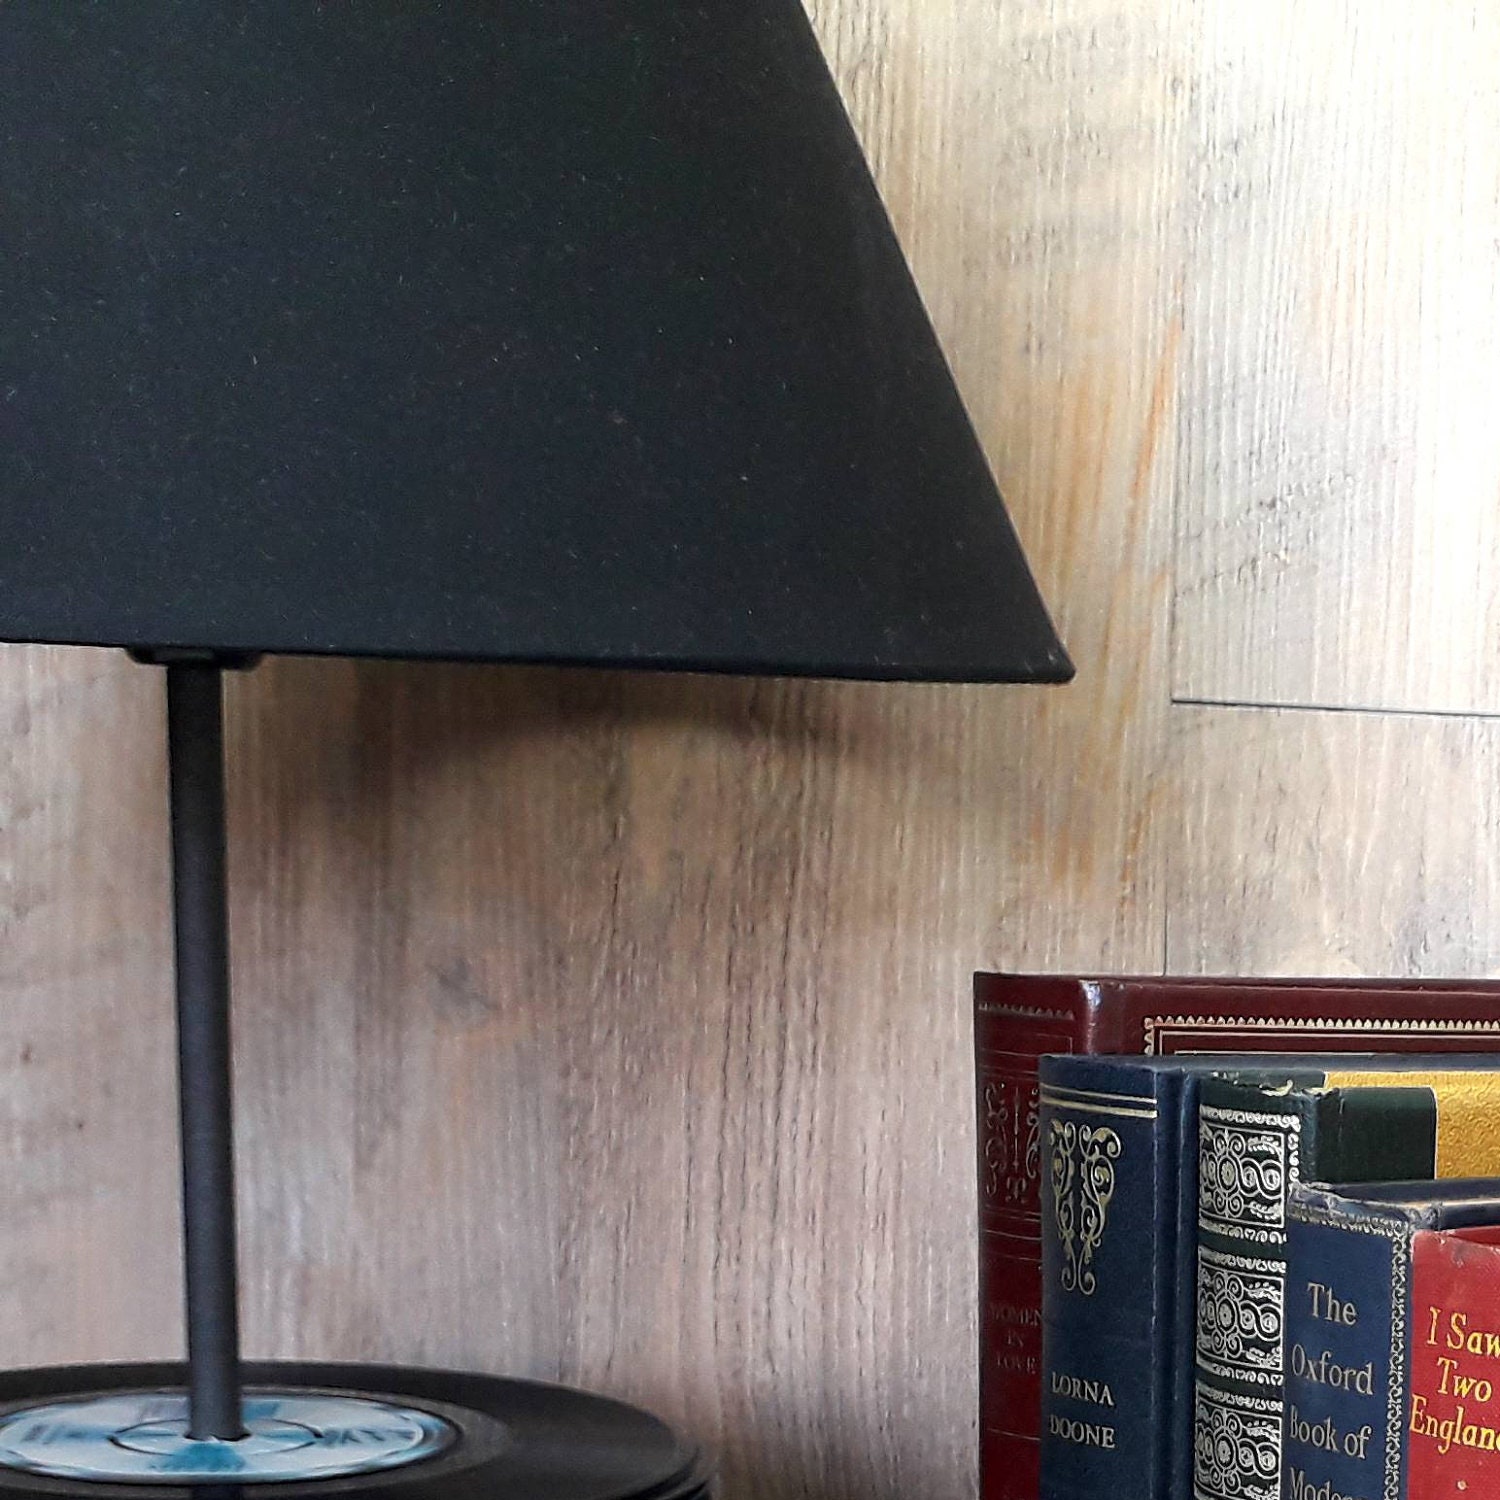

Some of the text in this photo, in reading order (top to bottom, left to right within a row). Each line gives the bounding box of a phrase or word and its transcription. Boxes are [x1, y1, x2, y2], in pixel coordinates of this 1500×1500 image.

[1307, 1282, 1357, 1325] The
[1426, 1306, 1441, 1345] I
[1051, 1371, 1114, 1407] LORNA
[1292, 1344, 1373, 1395] Oxford
[1437, 1357, 1492, 1402] Two
[1050, 1414, 1116, 1449] DOONE
[1290, 1405, 1372, 1459] Book of
